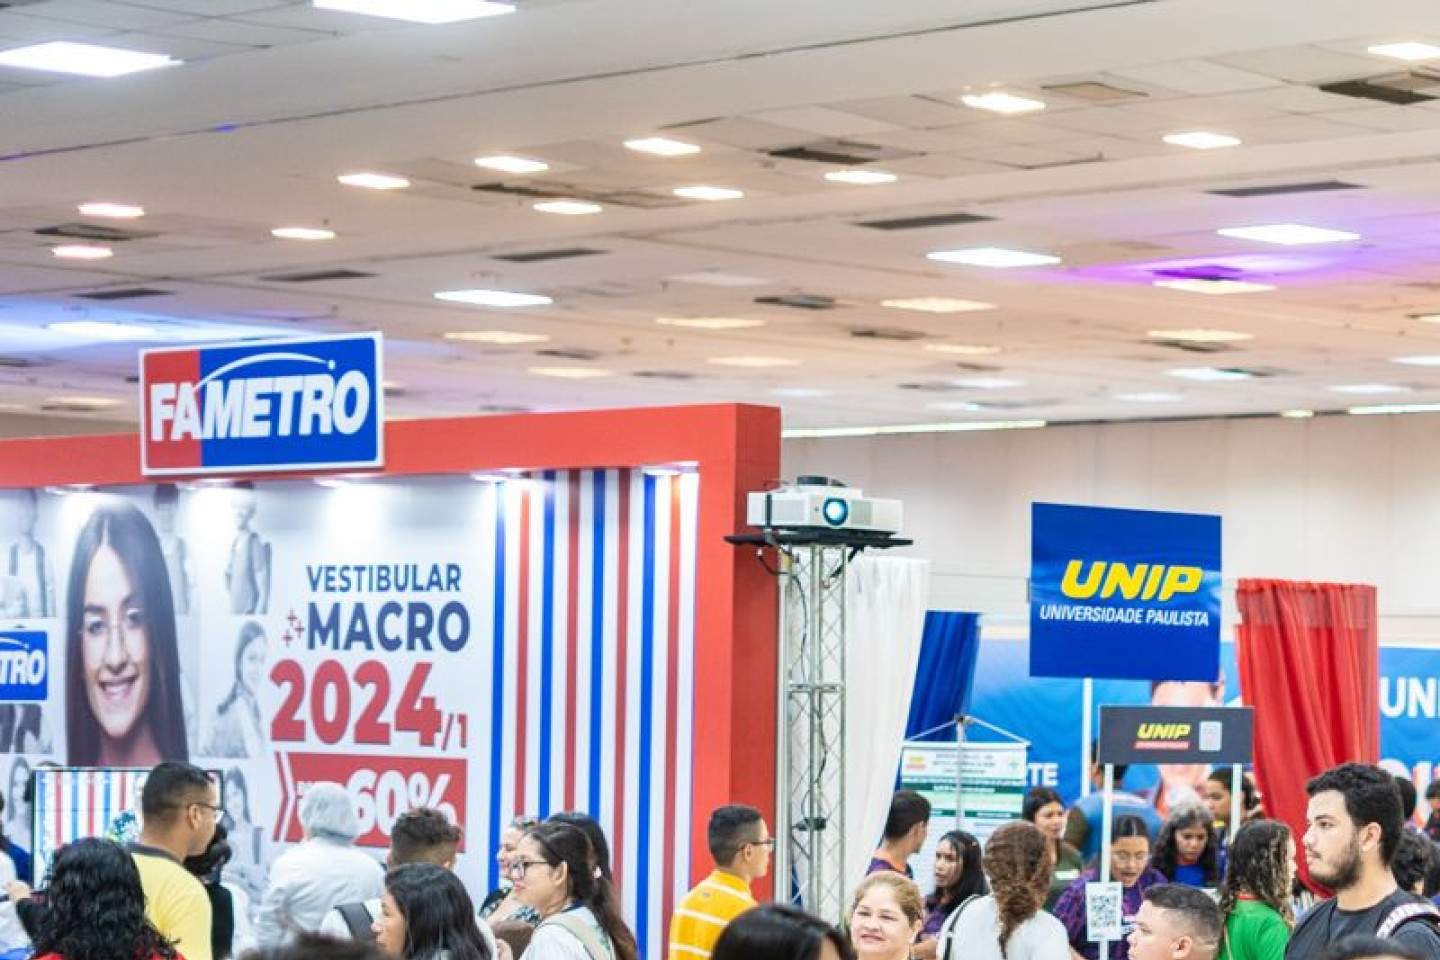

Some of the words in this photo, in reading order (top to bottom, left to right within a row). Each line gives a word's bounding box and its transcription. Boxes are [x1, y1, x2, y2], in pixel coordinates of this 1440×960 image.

[150, 369, 370, 442] FAMETRO
[306, 563, 462, 593] VESTIBULAR
[1061, 559, 1204, 601] UNIP
[307, 600, 471, 652] MACRO
[1039, 604, 1143, 624] UNIVERSIDADE
[1146, 609, 1209, 627] PAULISTA
[1137, 722, 1191, 740] UNIP
